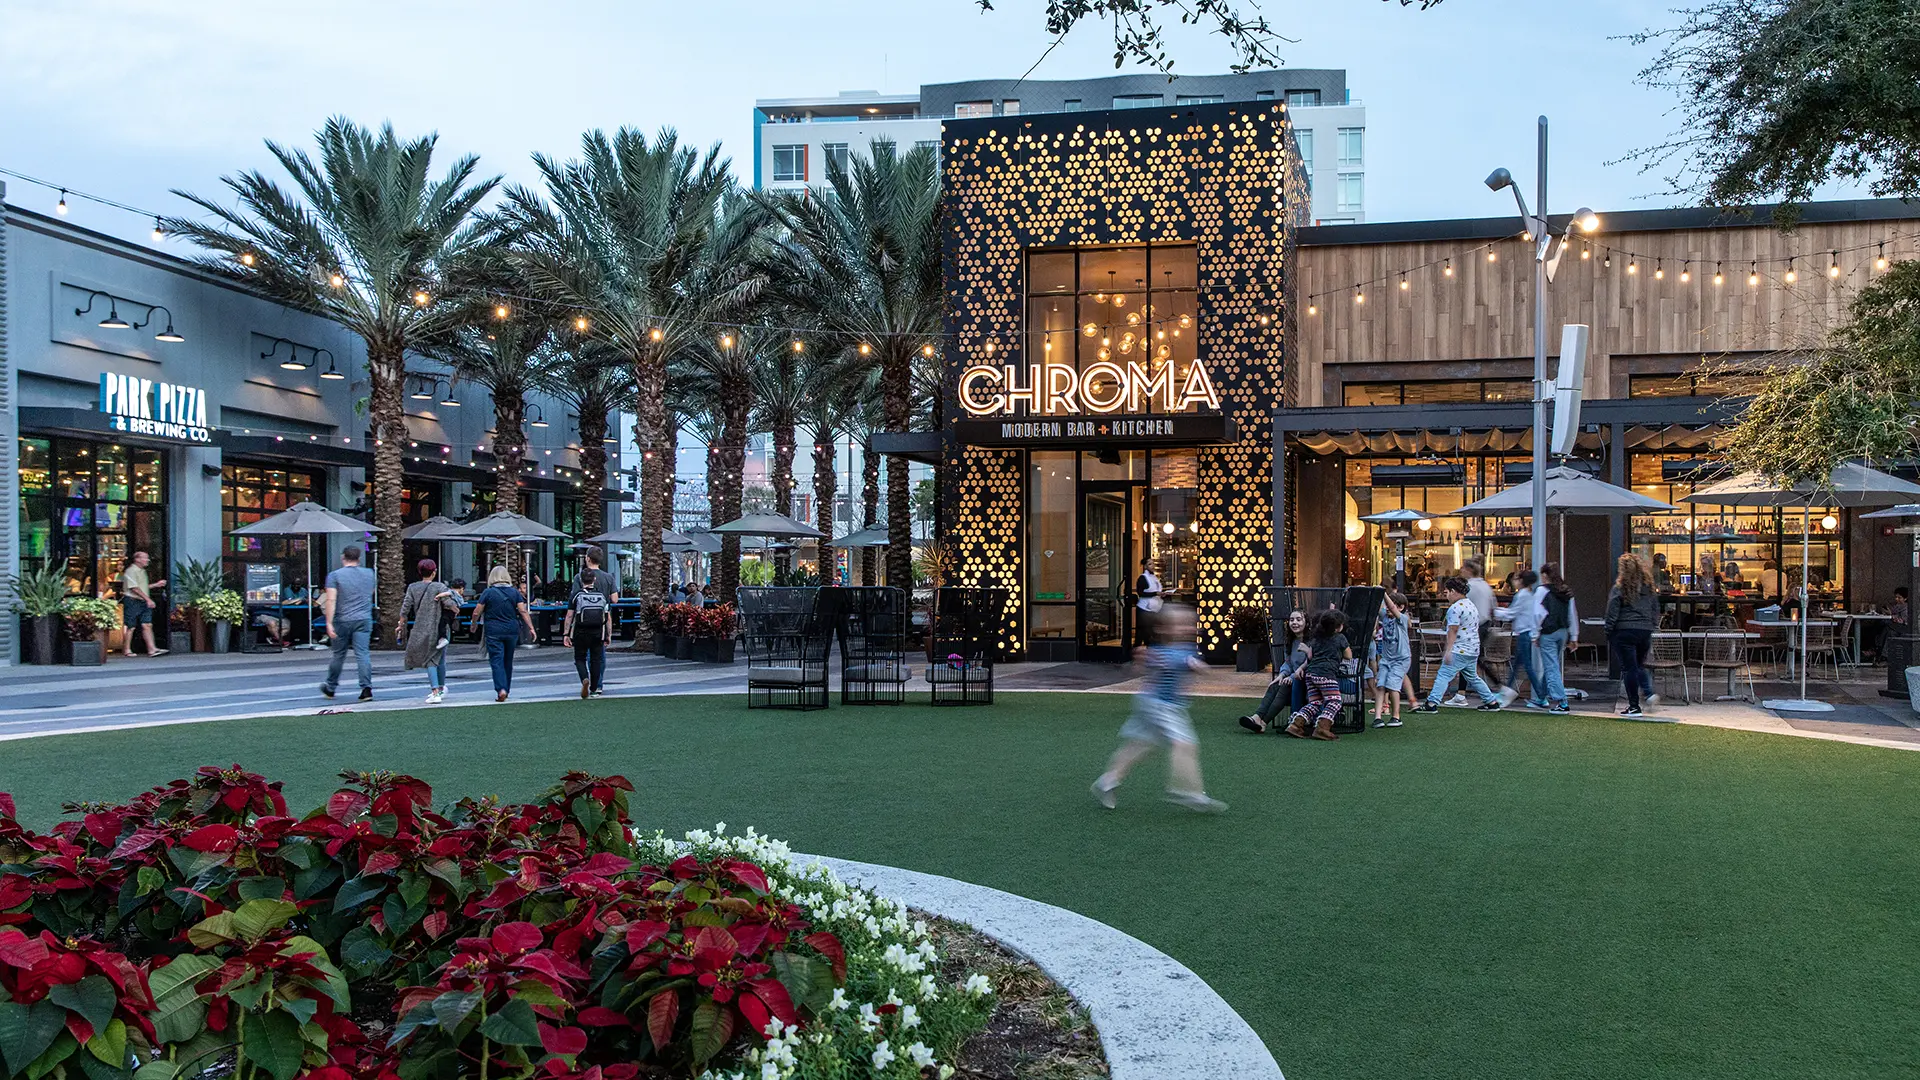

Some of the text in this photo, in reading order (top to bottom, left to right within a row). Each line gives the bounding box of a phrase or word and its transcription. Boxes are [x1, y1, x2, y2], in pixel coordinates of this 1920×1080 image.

[105, 372, 207, 427] PARK PIZZA
[958, 359, 1221, 415] CHROMA
[116, 416, 212, 443] & BREWING CO.
[1002, 422, 1061, 438] MODERN
[1067, 421, 1095, 437] BAR
[1112, 420, 1174, 436] KITCHEN
